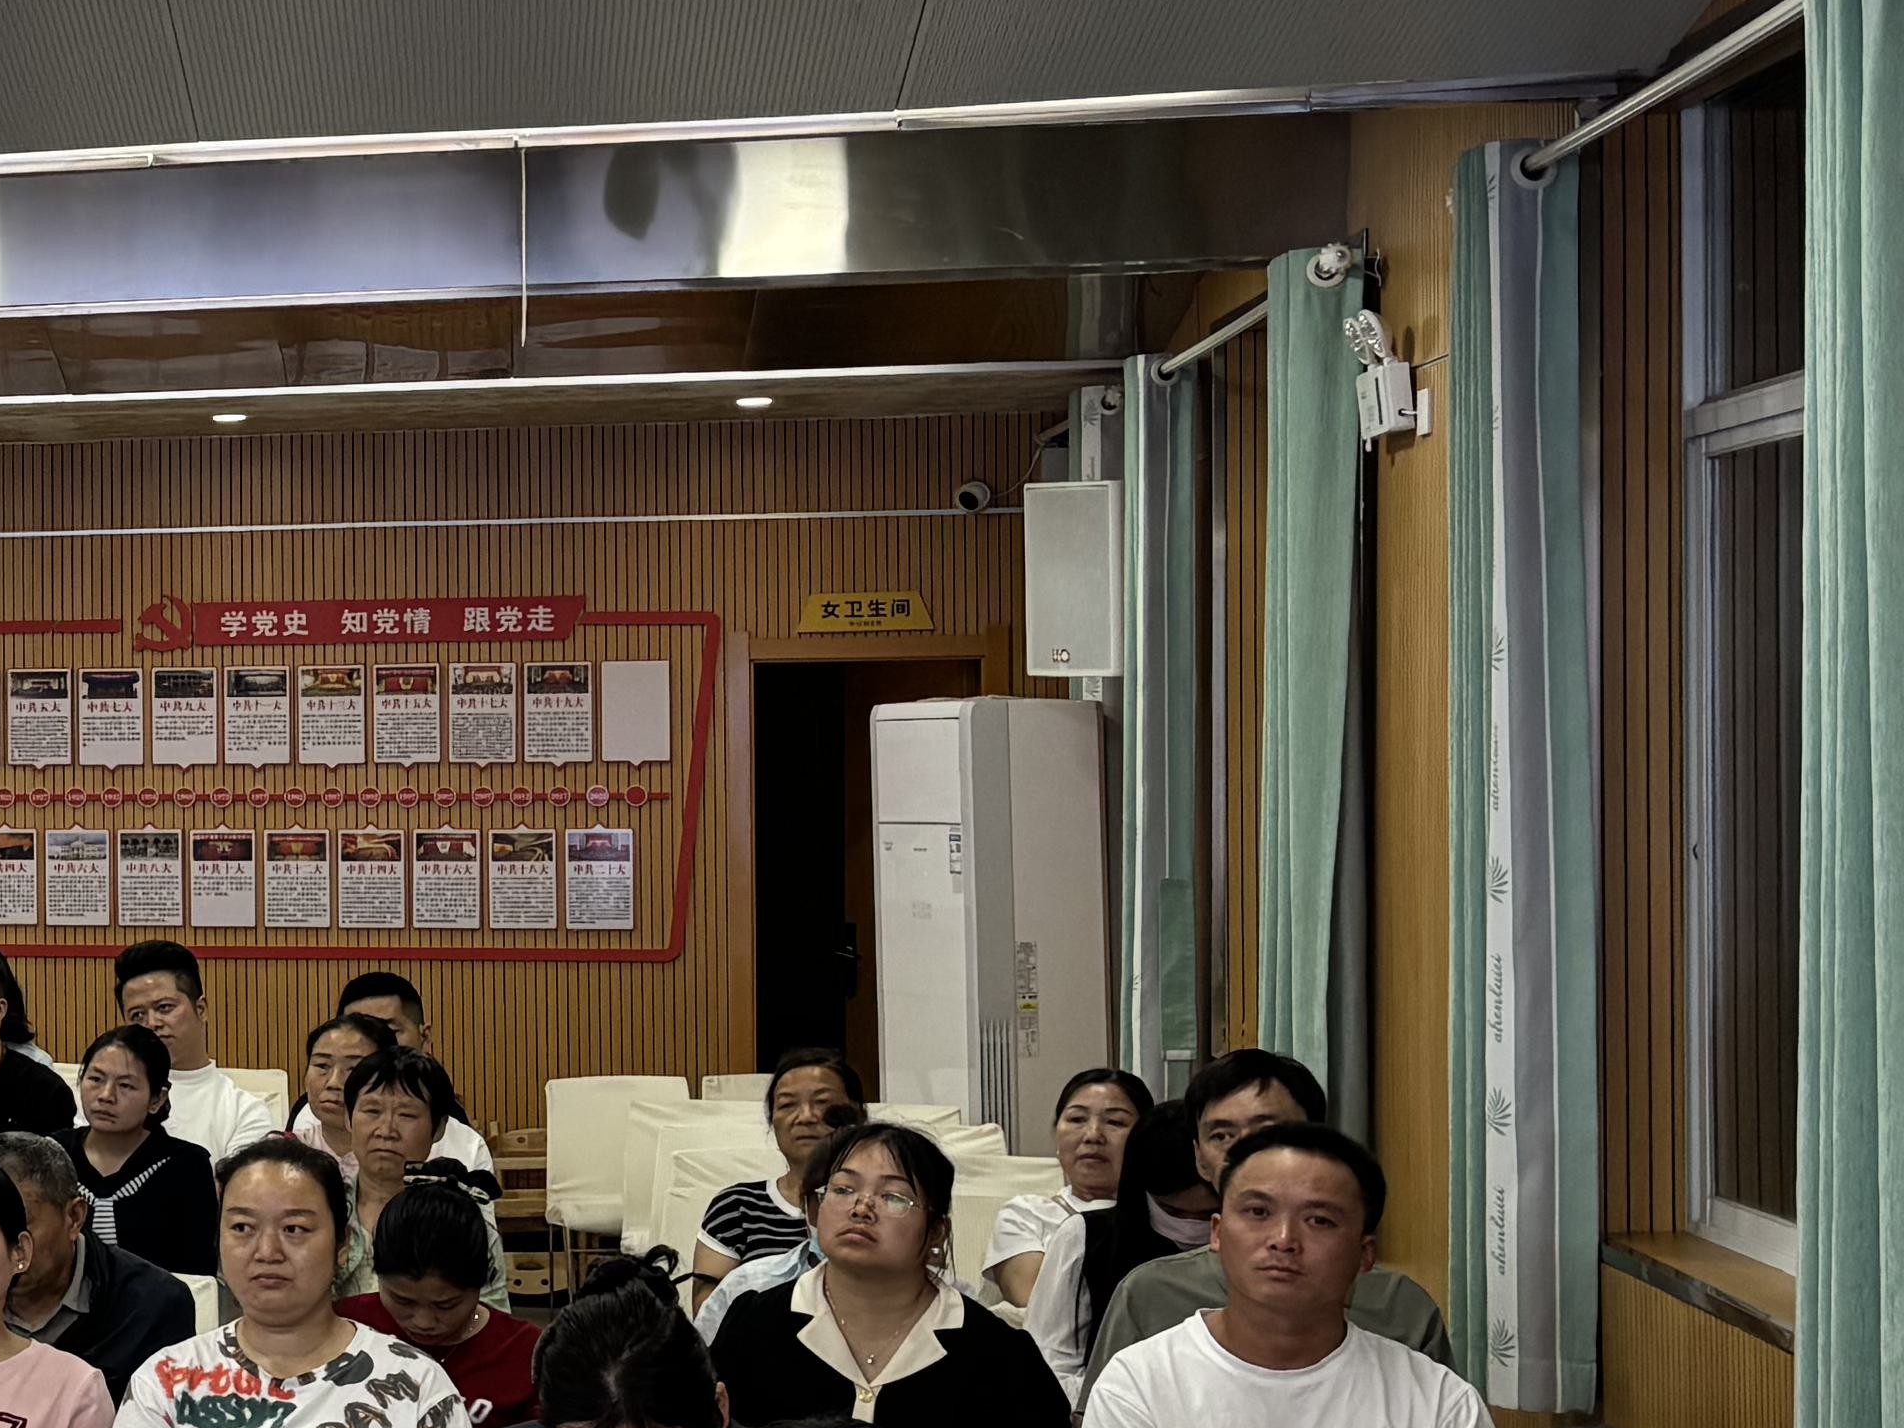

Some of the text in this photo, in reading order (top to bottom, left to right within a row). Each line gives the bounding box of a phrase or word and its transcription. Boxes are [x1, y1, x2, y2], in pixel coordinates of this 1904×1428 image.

[821, 599, 911, 619] 女卫生间
[220, 606, 555, 637] 学党史 知党情 跟党走
[160, 700, 207, 712] 中共九大
[532, 696, 584, 708] 中共十九大
[573, 864, 626, 875] 中共二十大
